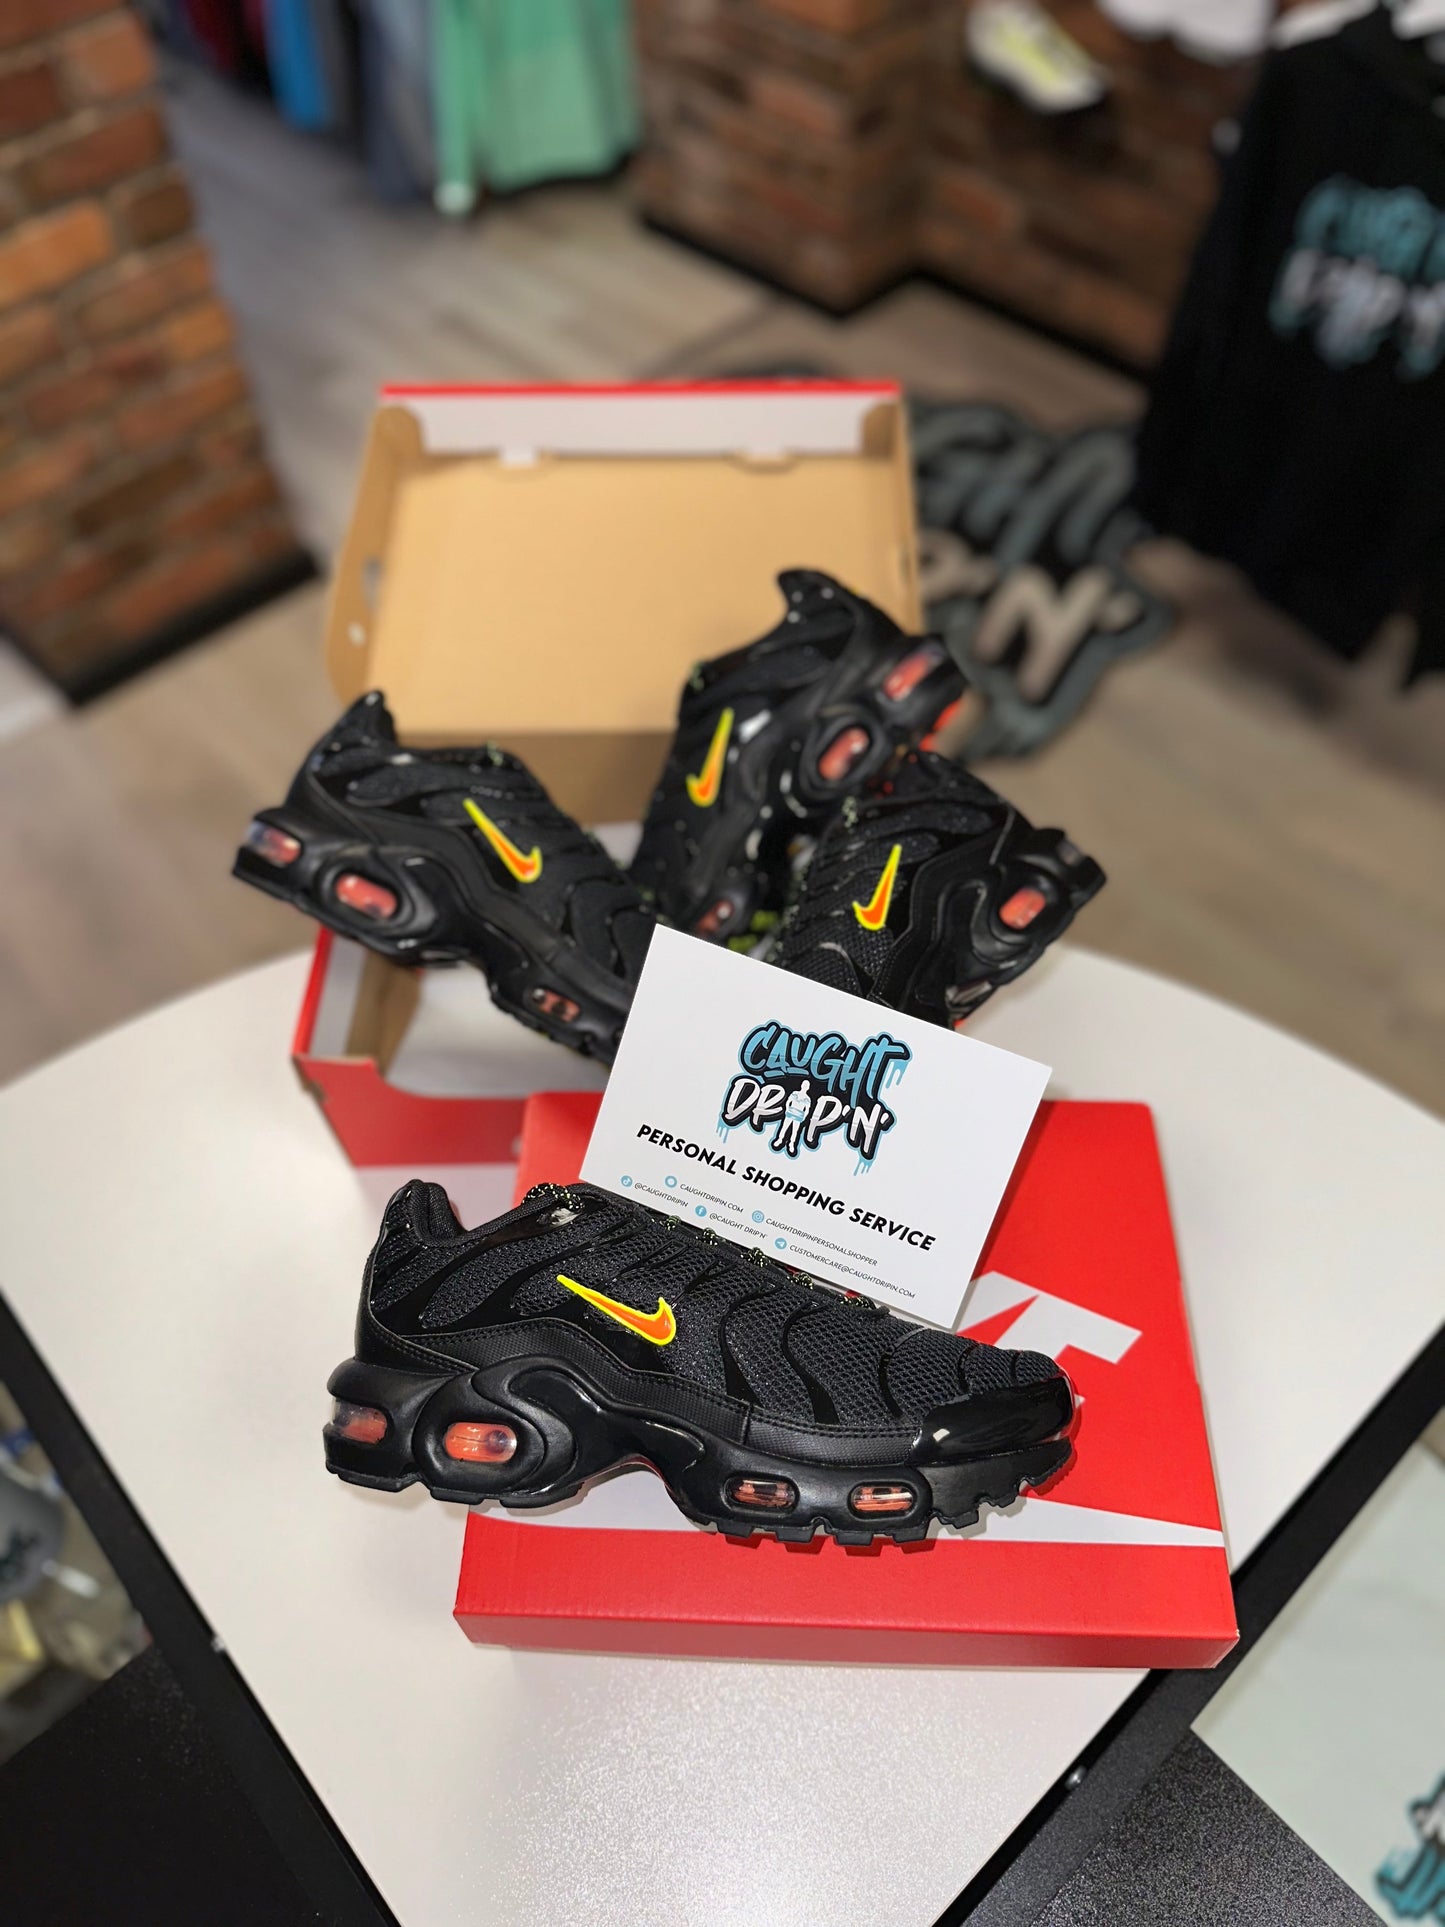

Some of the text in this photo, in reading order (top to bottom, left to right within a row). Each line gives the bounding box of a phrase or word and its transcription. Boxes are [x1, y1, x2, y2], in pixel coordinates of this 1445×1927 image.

[740, 1021, 911, 1108] CAUGHT
[634, 1182, 689, 1208] @CAUGHTDRIPIN
[636, 1124, 936, 1251] PERSONAL SHOPPING SERVICE
[709, 1212, 744, 1230] @CAUGHT
[765, 1218, 878, 1267] CAUGHTDRIPINPERSONALSHOPPER
[789, 1244, 916, 1299] CUSTOMERCARE@CAUGHTDRIPIN.COM
